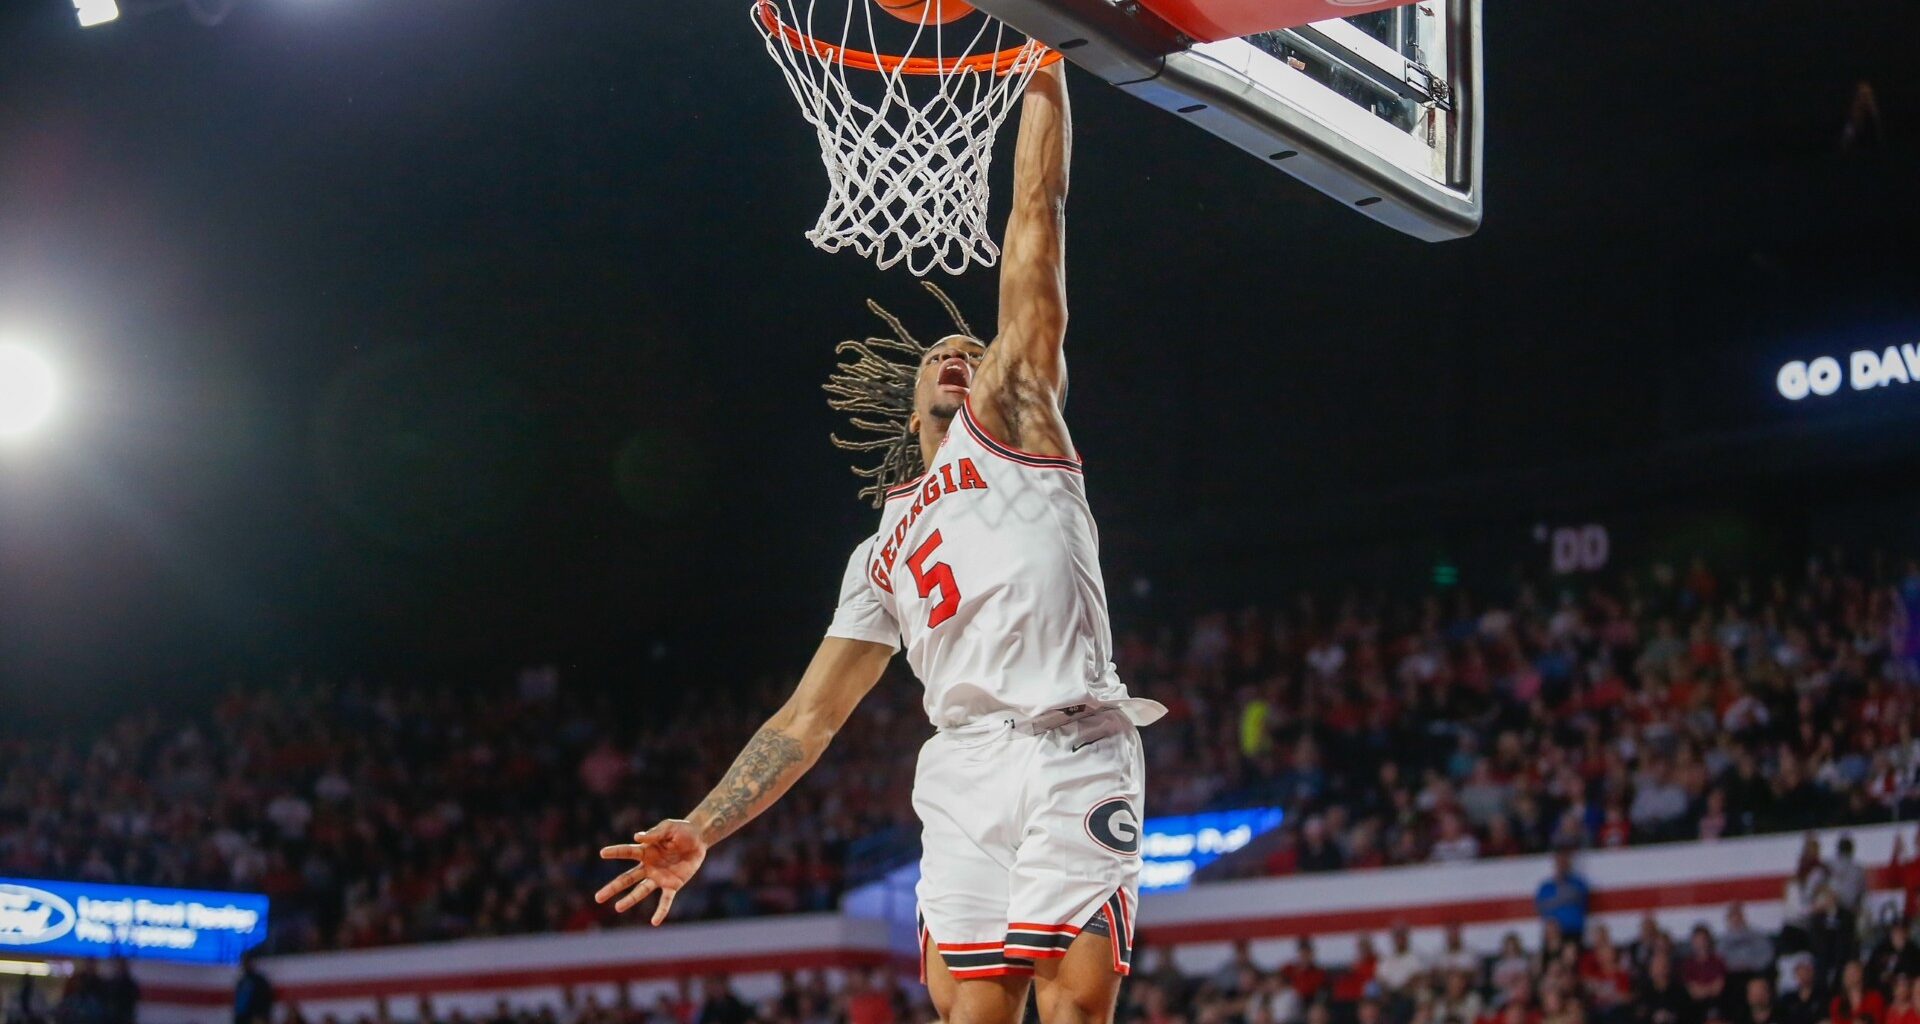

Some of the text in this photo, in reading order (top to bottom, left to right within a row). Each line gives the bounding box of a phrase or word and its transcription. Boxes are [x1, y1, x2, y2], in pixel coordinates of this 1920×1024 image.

[1776, 356, 1842, 401] GO
[870, 457, 988, 595] GEORGIA
[906, 528, 962, 630] 5
